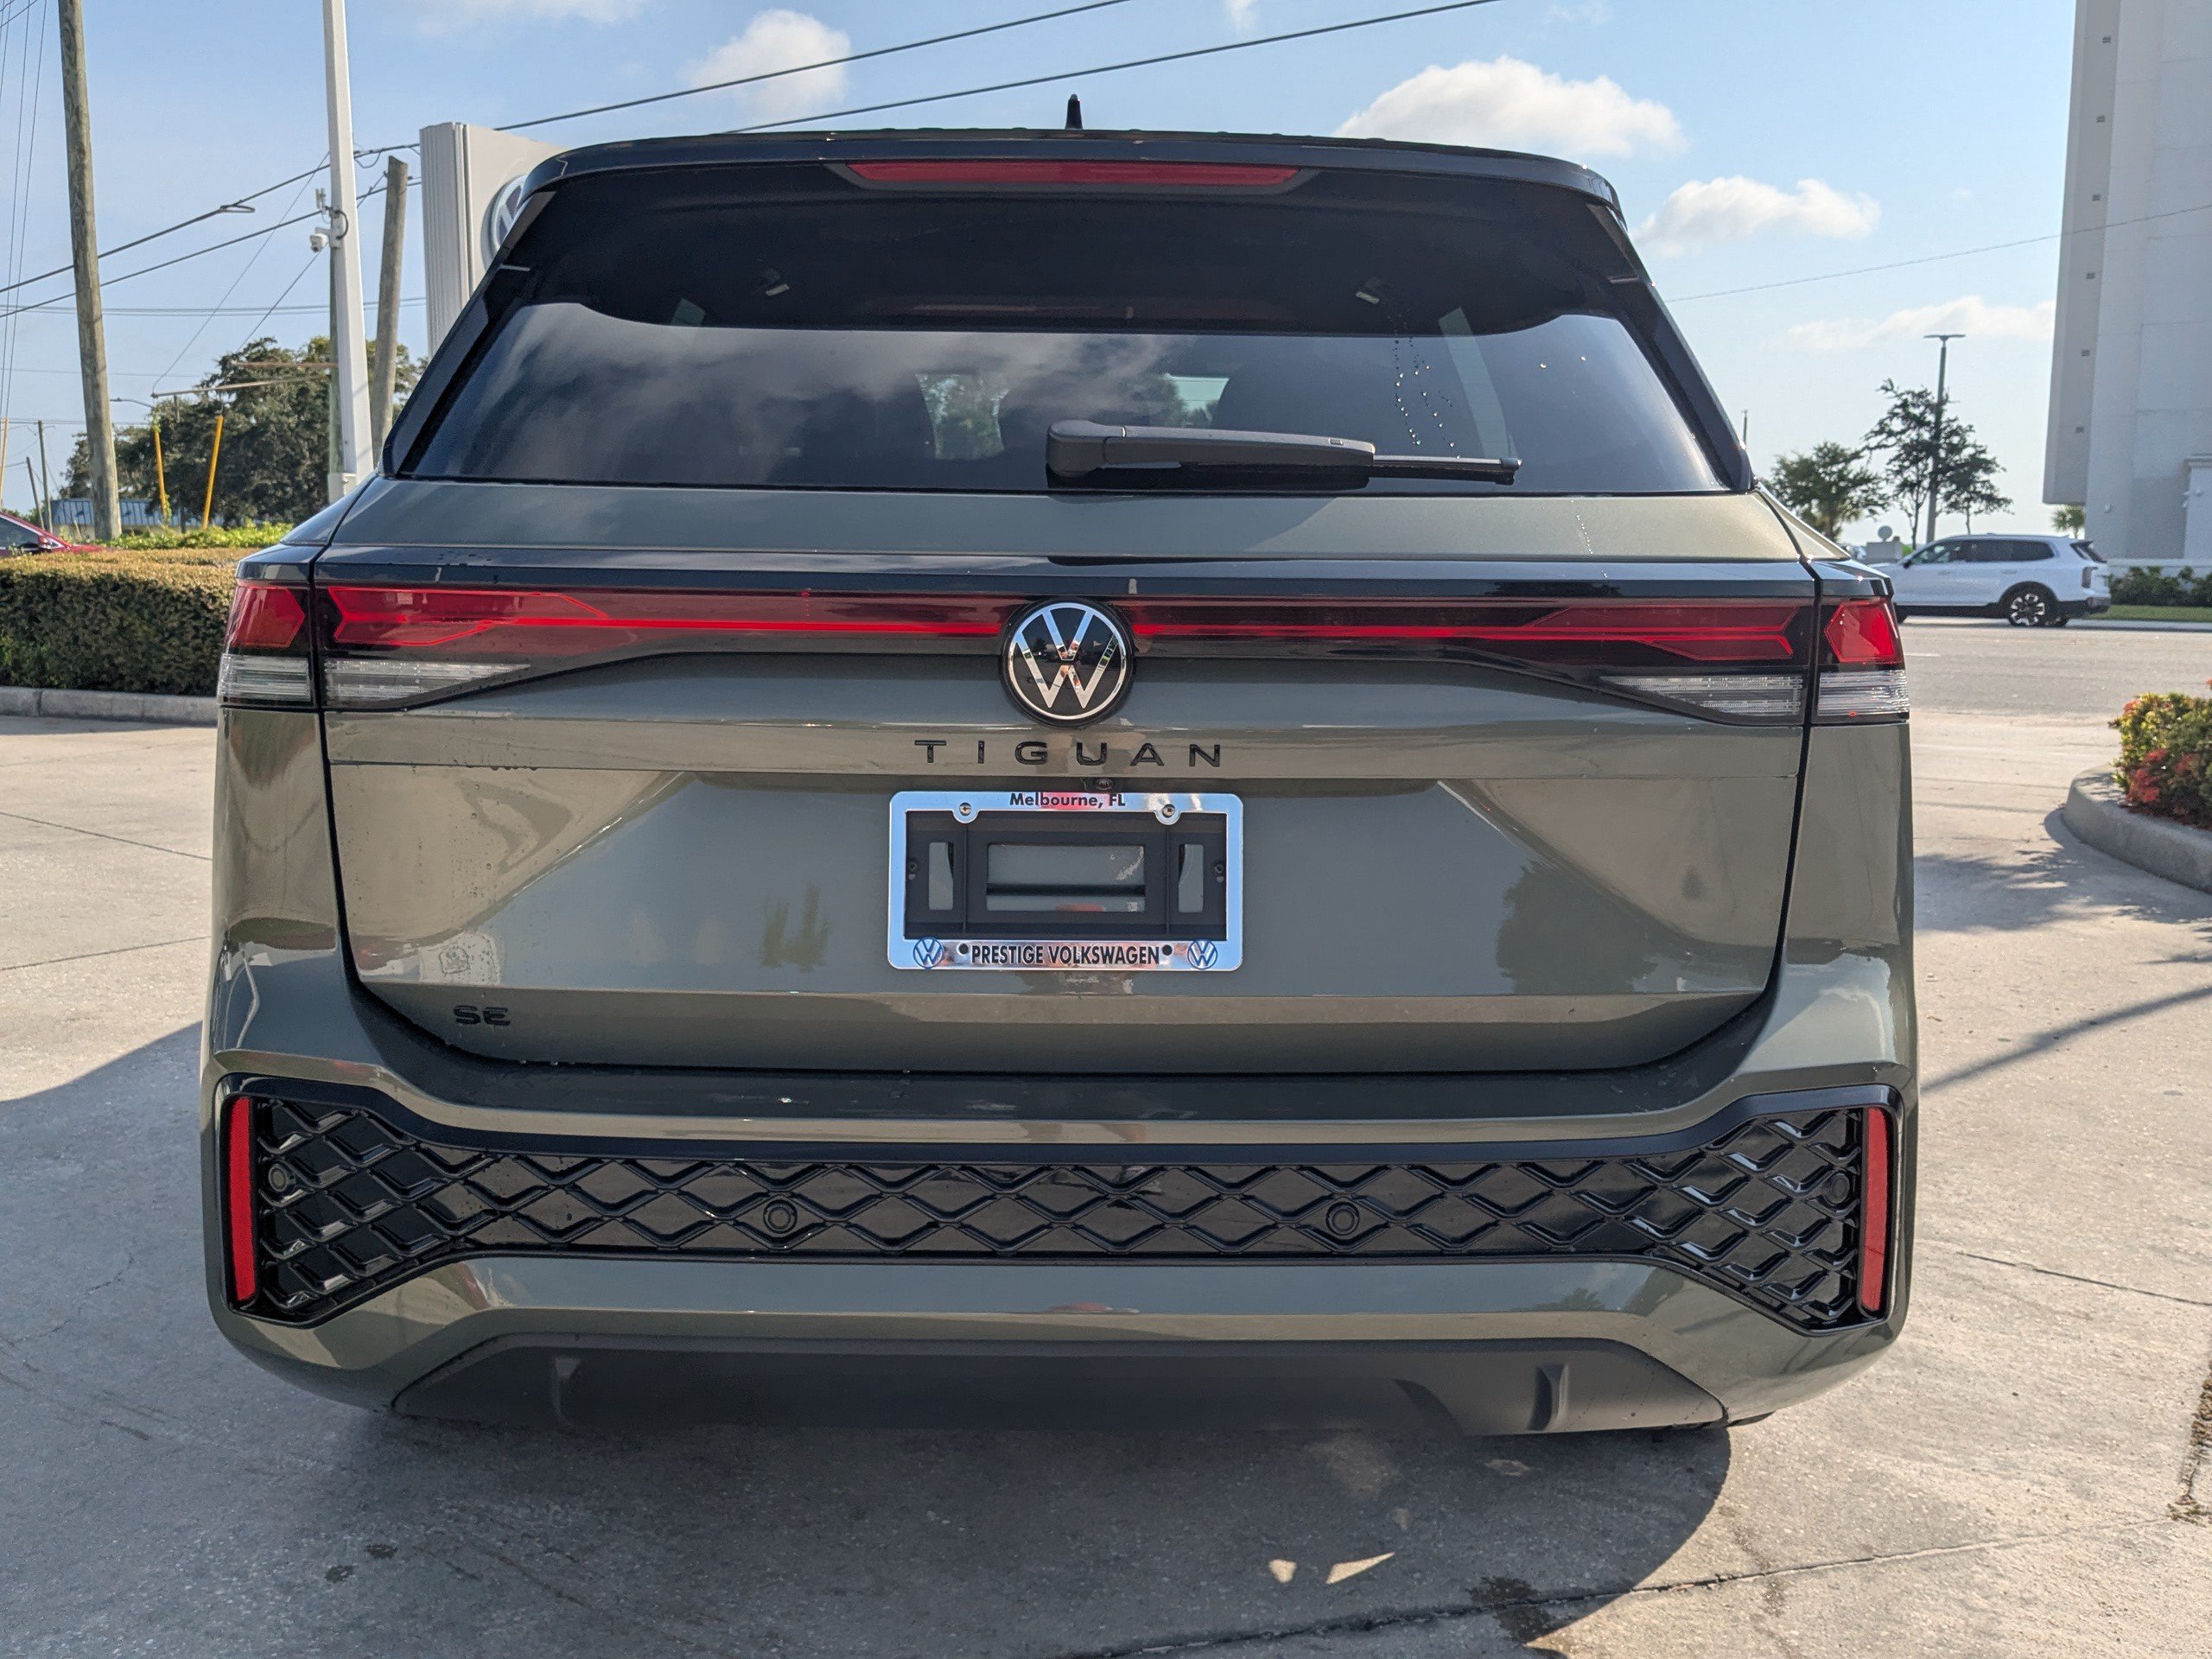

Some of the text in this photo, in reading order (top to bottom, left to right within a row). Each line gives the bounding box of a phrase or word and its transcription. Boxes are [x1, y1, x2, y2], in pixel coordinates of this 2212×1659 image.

[914, 739, 1221, 768] TIGUAN
[1009, 792, 1126, 810] Melbourne, FL
[970, 944, 1160, 966] PRESTIGE VOLKSWAGEN
[453, 1004, 511, 1027] SE
